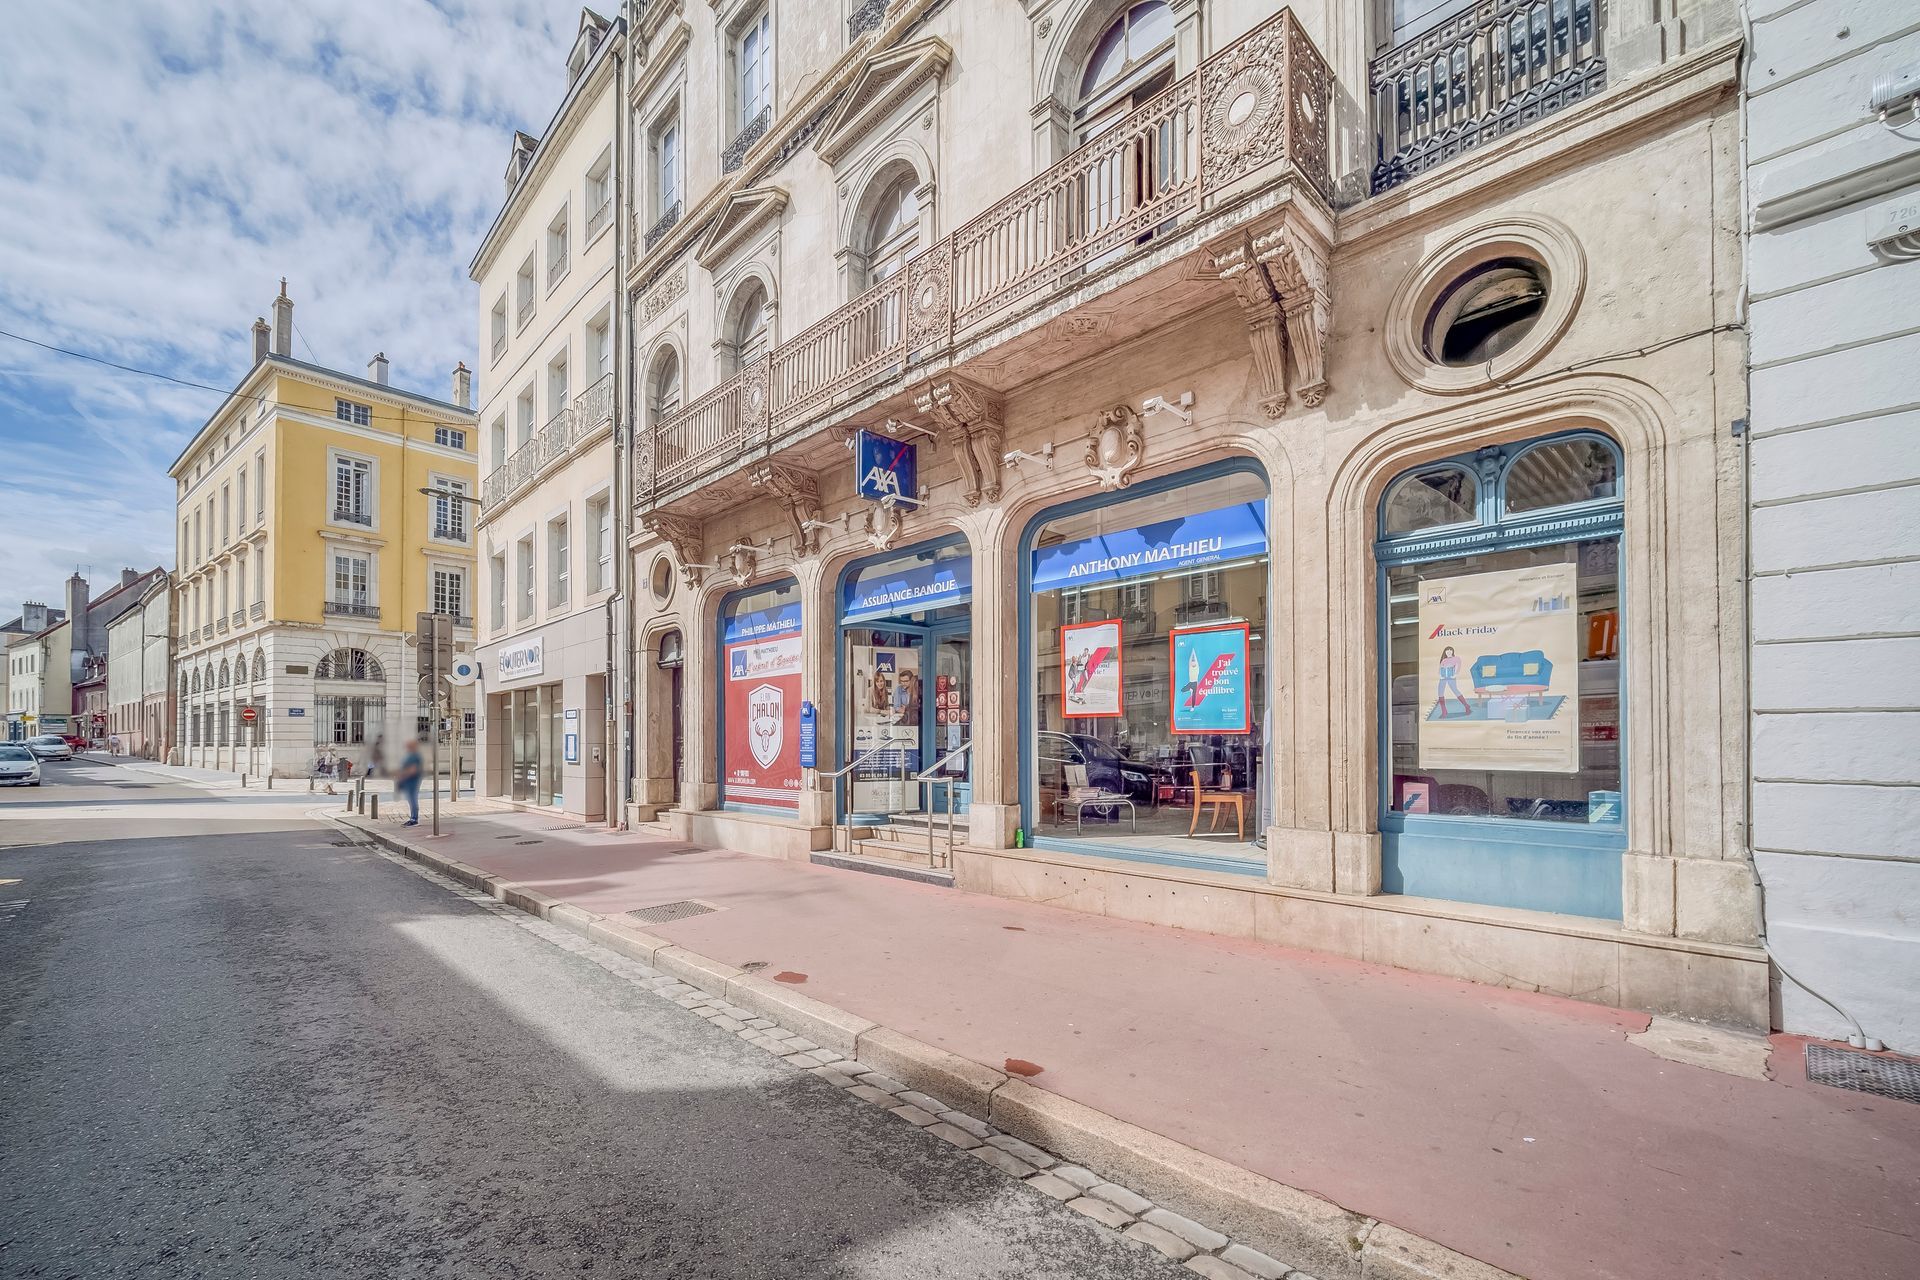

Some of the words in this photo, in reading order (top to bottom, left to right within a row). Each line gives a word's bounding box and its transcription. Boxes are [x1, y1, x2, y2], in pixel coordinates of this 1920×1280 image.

[1890, 205, 1917, 222] 726
[861, 466, 901, 496] AXA
[1068, 552, 1142, 577] ANTHONY
[1145, 537, 1222, 563] MATHIEU
[862, 588, 912, 608] ASSURANCE
[914, 579, 956, 597] BANQUE
[741, 624, 766, 637] PHILIPPE
[767, 618, 796, 632] MATHIEU
[1437, 626, 1463, 637] Black
[1466, 625, 1498, 636] Friday
[876, 662, 893, 673] AXA
[1217, 658, 1231, 668] J'ai
[1211, 667, 1239, 677] trouvé
[1205, 678, 1213, 686] le
[1213, 677, 1230, 686] bon
[1199, 686, 1235, 697] équilibre
[752, 702, 780, 722] CHALON
